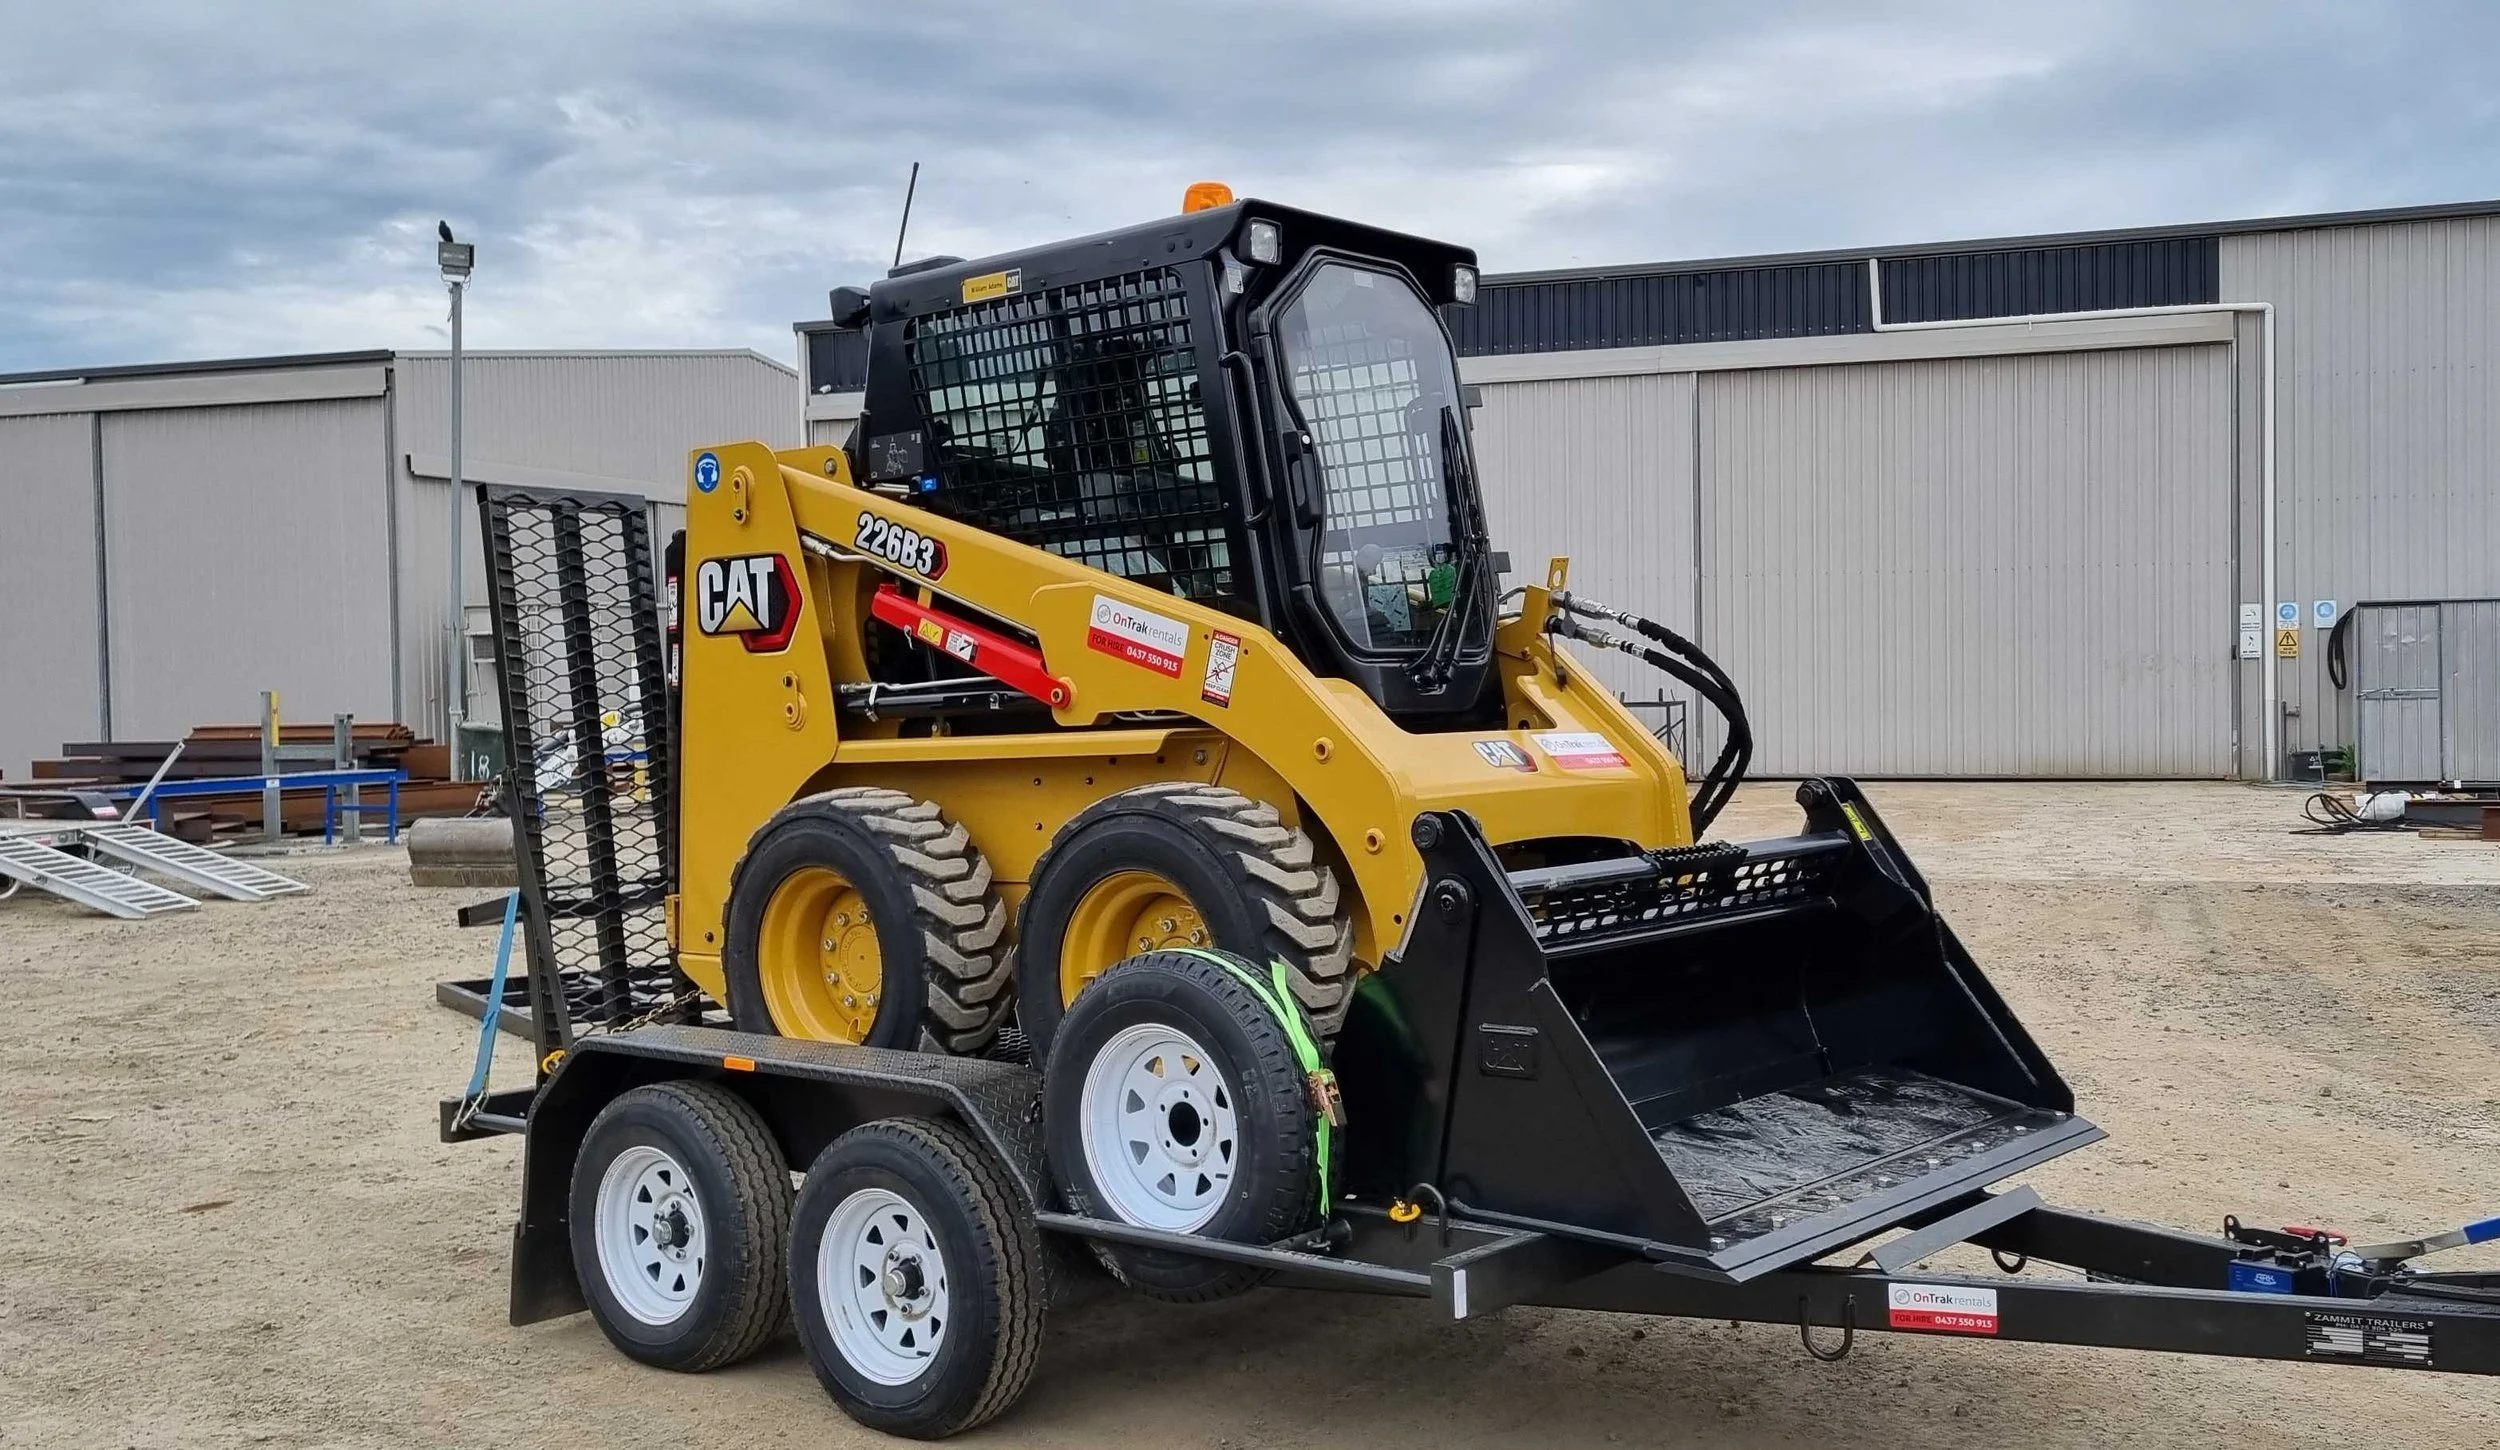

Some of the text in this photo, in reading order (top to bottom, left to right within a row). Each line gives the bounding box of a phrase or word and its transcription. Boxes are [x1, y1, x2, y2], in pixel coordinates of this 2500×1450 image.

[1007, 275, 1019, 289] CAT
[855, 512, 935, 575] 226B3
[698, 556, 774, 633] CAT
[1092, 633, 1178, 672] FOR HIRE 0437 550 915
[1214, 641, 1236, 654] CRUSH
[1215, 649, 1232, 660] ZONE
[1473, 741, 1525, 767] CAT
[1895, 1314, 1992, 1328] FOR HIRE 0437 550 915
[2314, 1313, 2425, 1330] ZAMMIT TRAILERS
